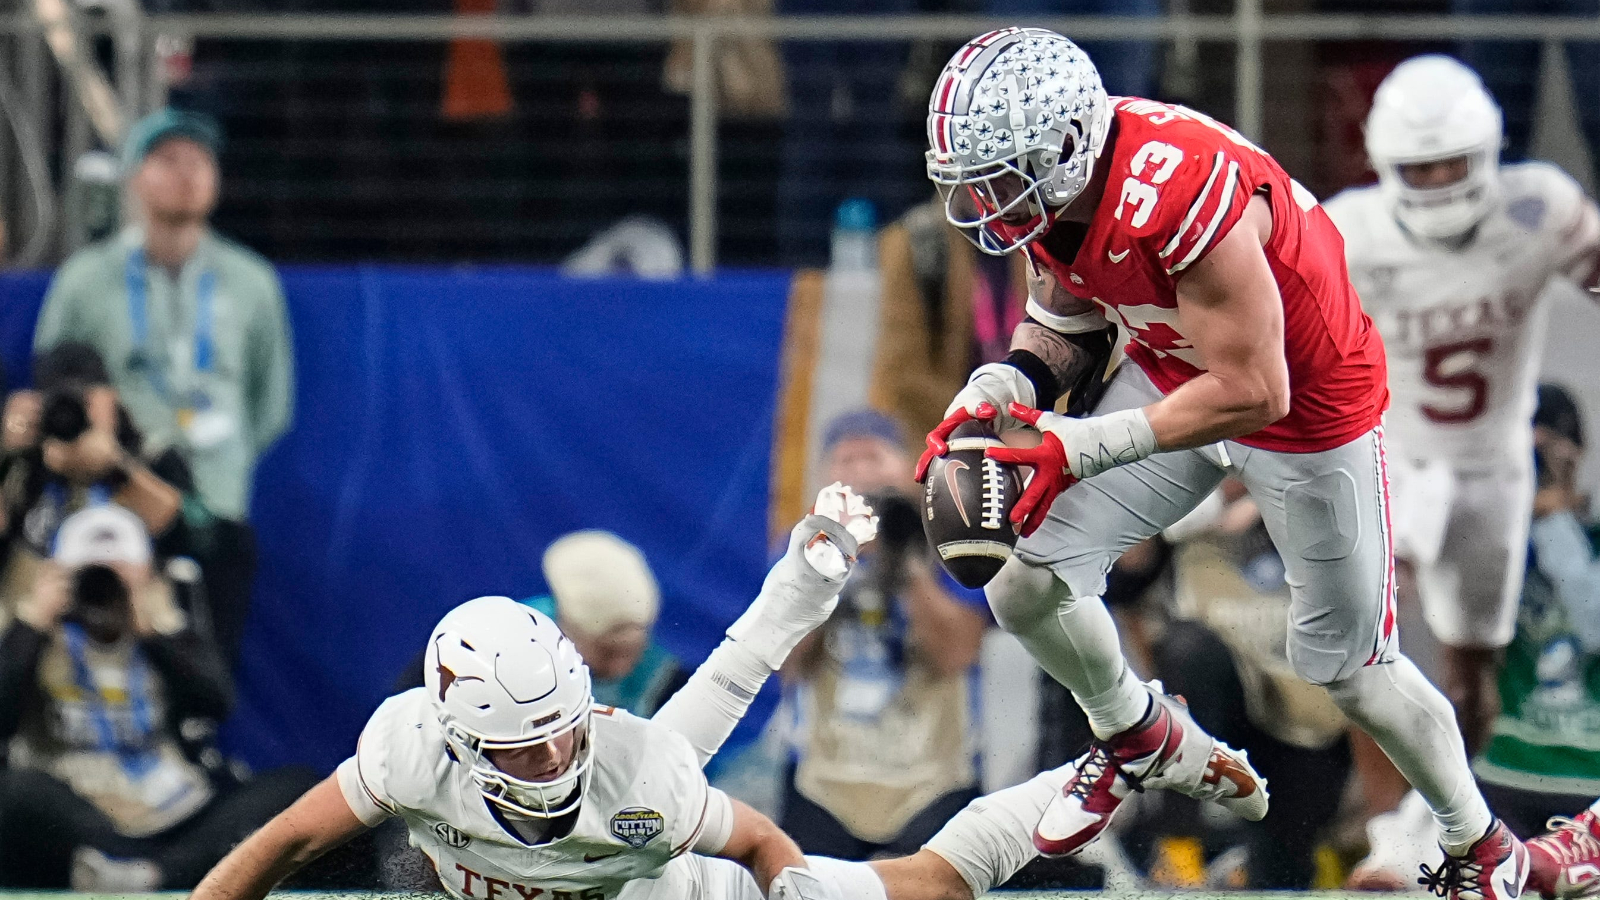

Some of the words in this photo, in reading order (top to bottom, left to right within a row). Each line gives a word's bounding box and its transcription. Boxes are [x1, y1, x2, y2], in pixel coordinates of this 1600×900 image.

[1114, 140, 1184, 229] 33
[1418, 337, 1493, 426] 5
[437, 823, 468, 847] SEC
[614, 819, 660, 834] COTTON
[456, 863, 605, 900] TEX
